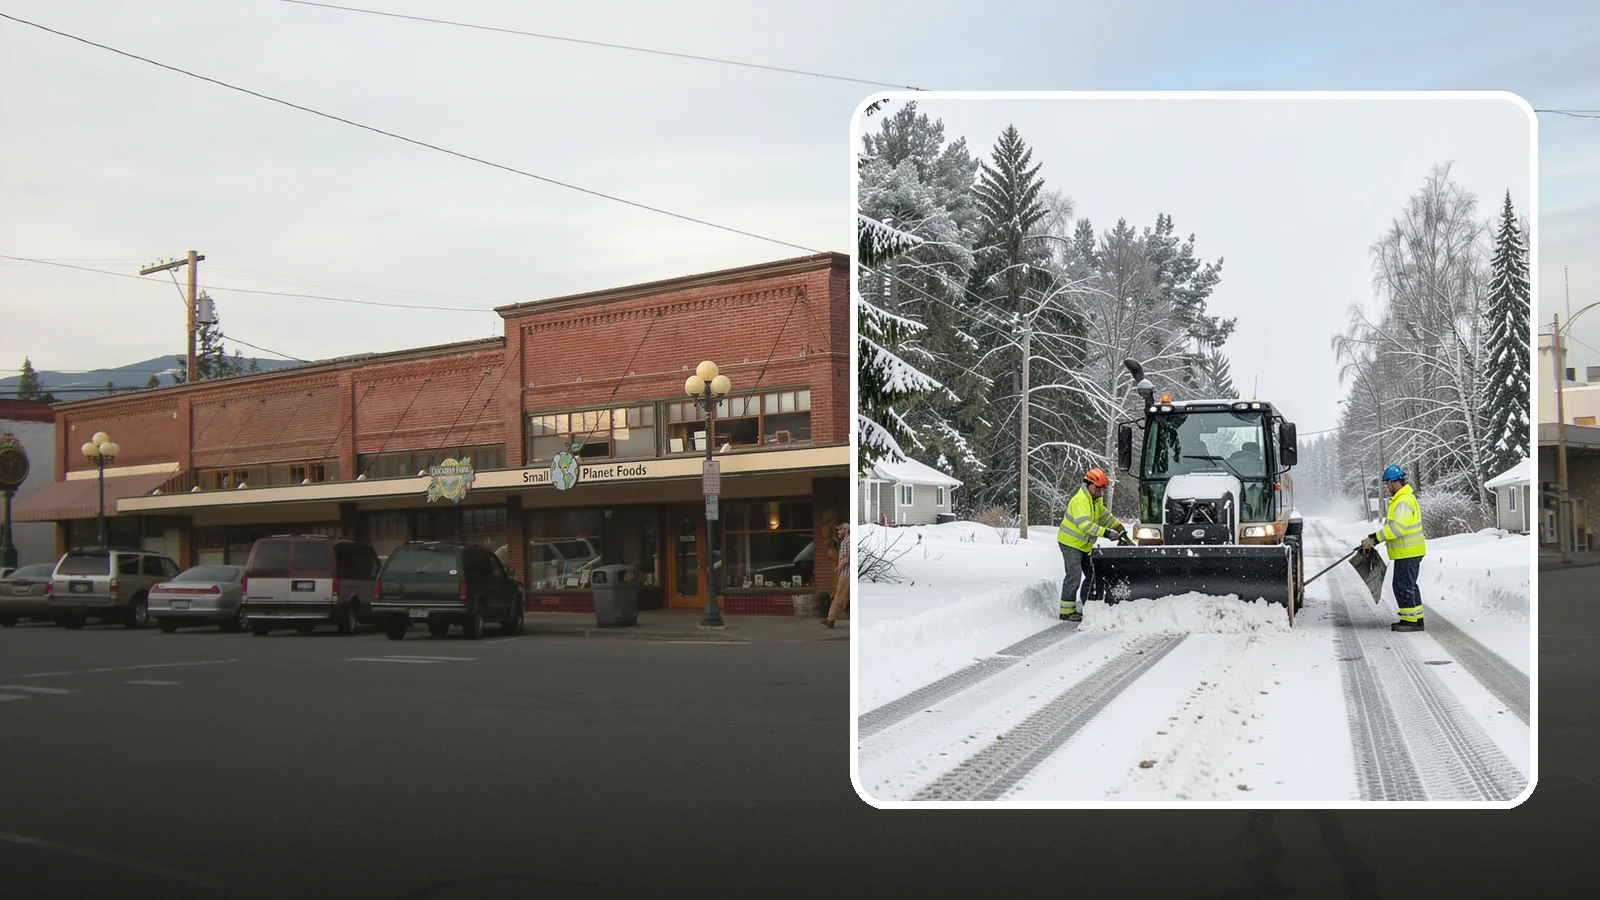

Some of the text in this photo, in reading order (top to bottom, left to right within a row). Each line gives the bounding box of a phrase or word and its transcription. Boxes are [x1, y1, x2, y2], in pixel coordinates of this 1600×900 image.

[431, 467, 455, 476] CASCADIAN
[523, 464, 647, 483] Small Planet Foods
